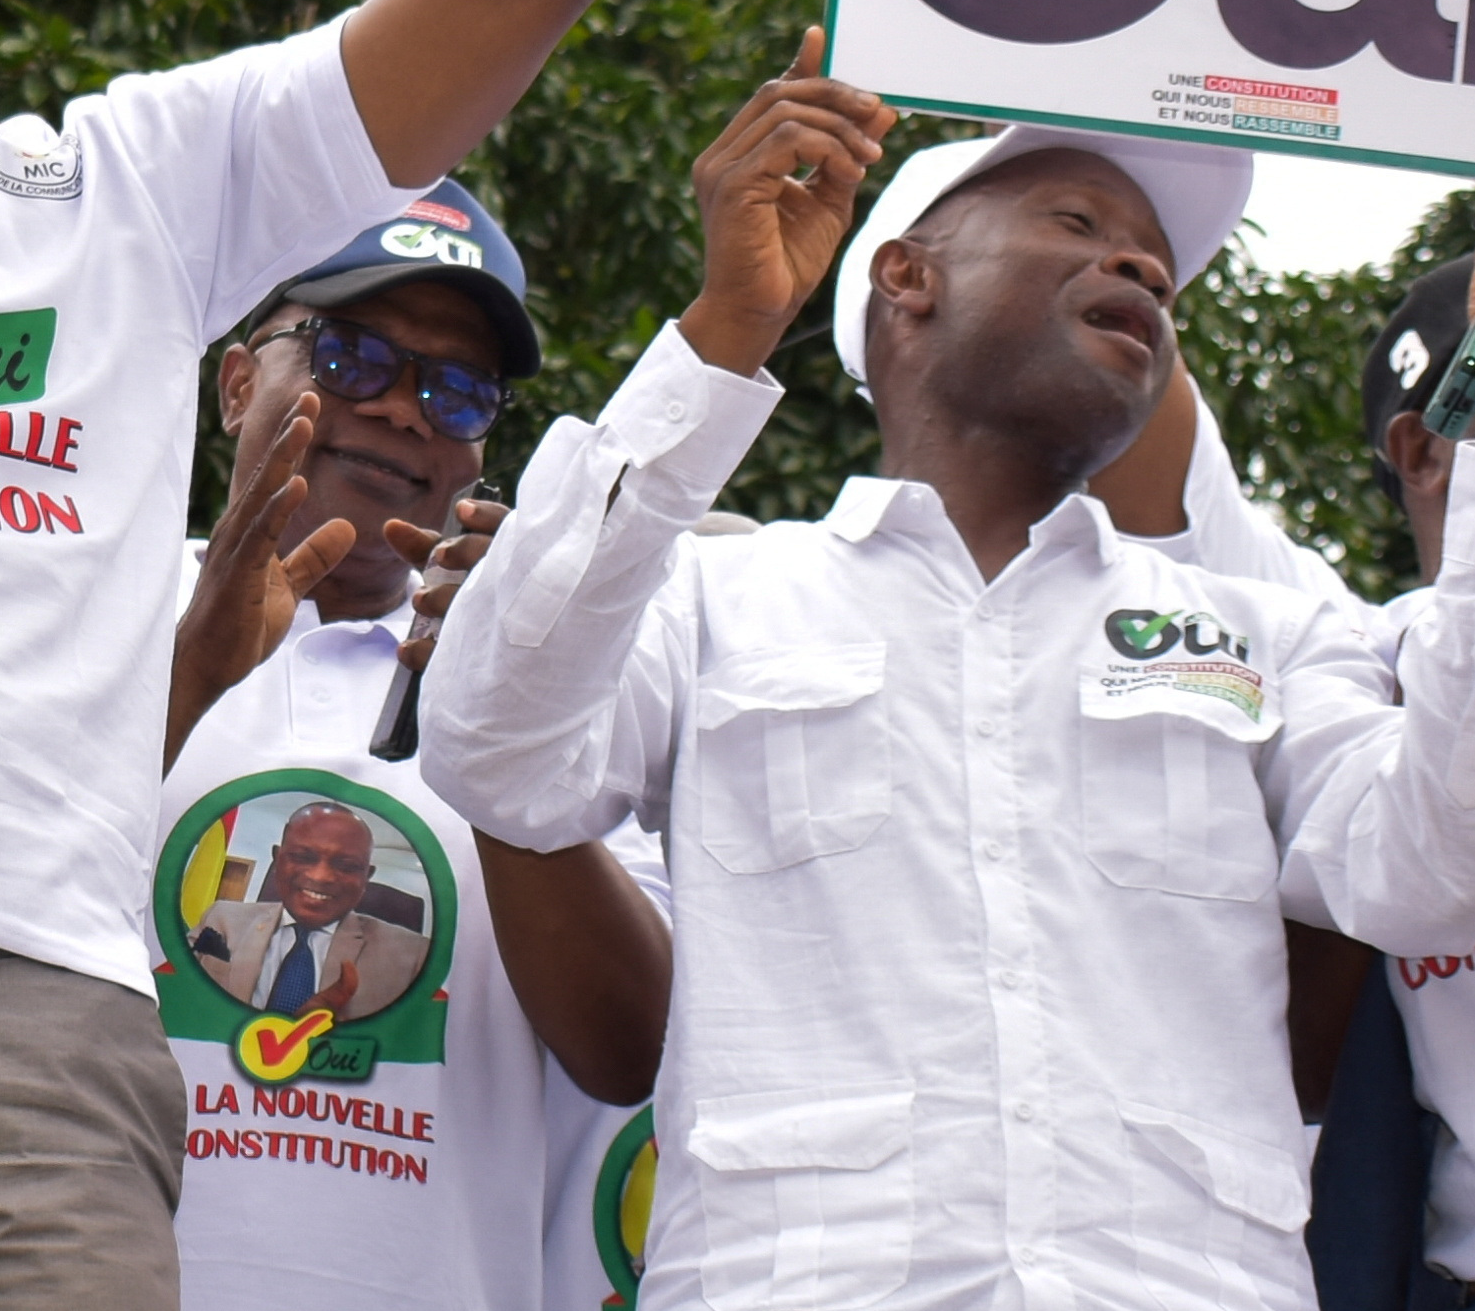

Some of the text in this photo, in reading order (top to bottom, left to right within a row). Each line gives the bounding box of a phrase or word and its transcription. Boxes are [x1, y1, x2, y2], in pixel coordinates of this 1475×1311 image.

[1168, 72, 1330, 103] UNE CONSTITUTION
[1151, 88, 1338, 123] QUI NOUS RESSEMBLE
[1157, 106, 1339, 139] ET NOUS RASSEMBLE
[11, 181, 24, 193] LA
[23, 161, 66, 180] MIC
[308, 1039, 361, 1072] Oui
[195, 1083, 435, 1143] LA NOUVELLE
[185, 1128, 428, 1184] ONSTITUTION
